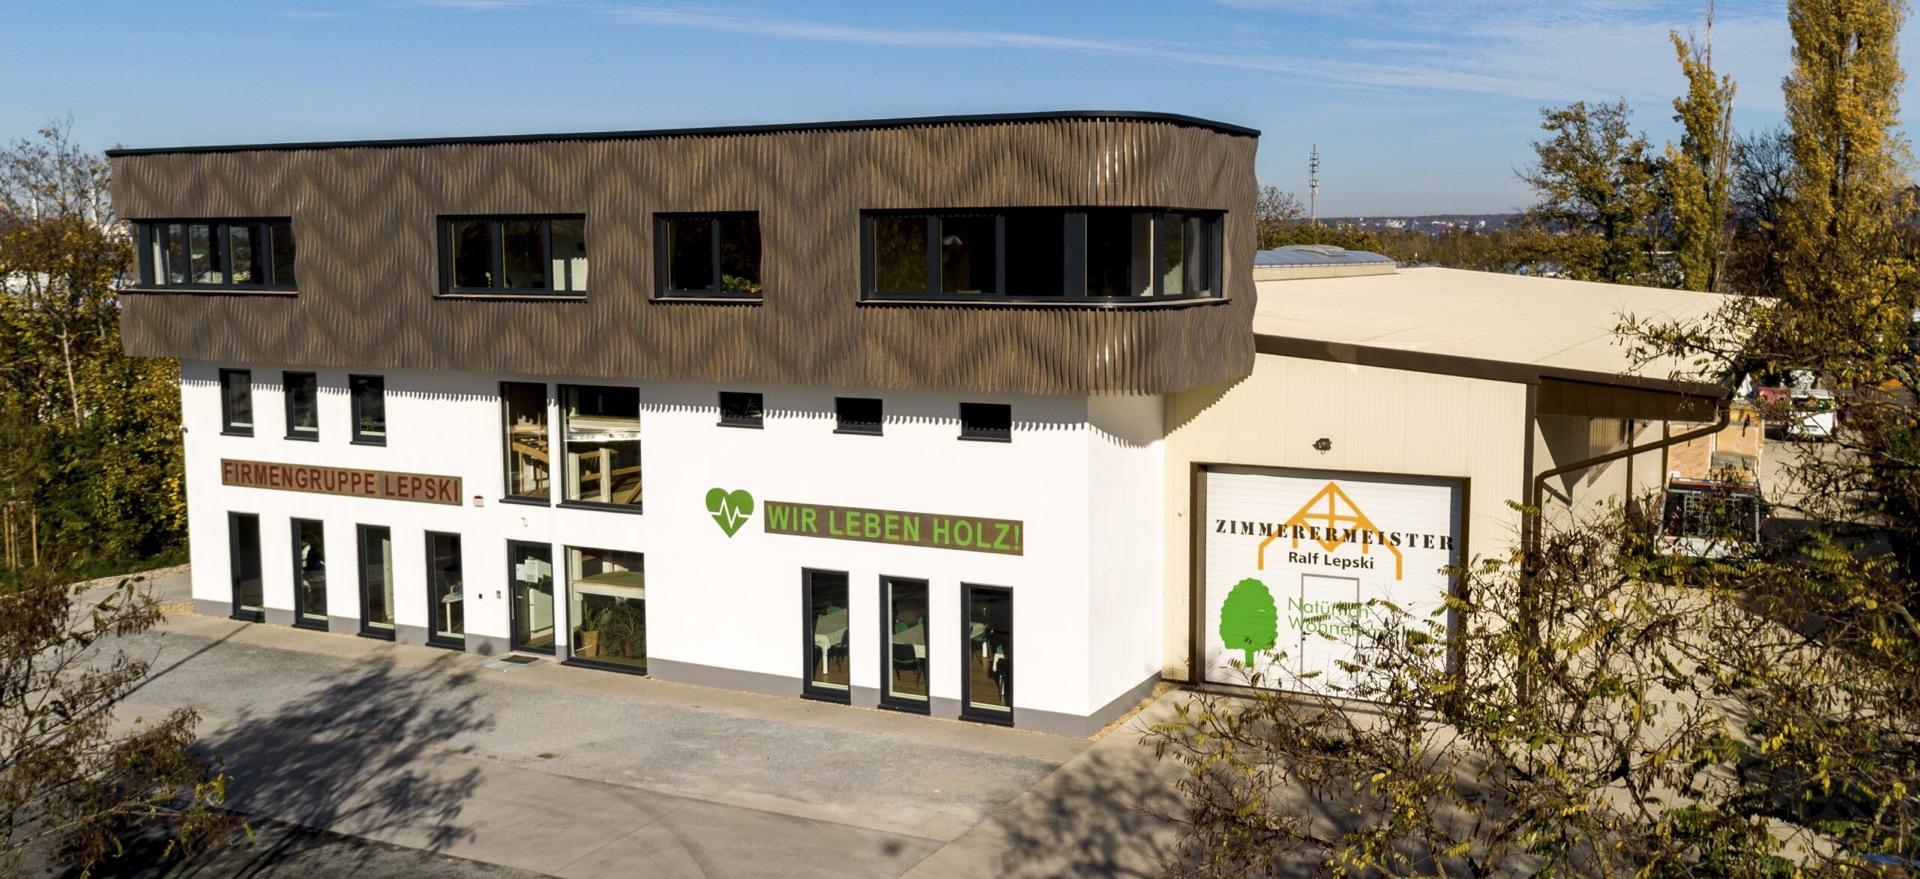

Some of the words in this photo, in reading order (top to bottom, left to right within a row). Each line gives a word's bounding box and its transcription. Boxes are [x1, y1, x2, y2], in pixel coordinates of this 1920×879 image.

[224, 462, 375, 495] FIRMENGRUPPE
[385, 475, 460, 502] LEPSKI
[768, 505, 818, 533] WIR
[829, 511, 919, 542] LEBEN
[932, 519, 1020, 551] HOLZ!
[1216, 519, 1455, 551] ZIMMERERMEISTER
[1288, 552, 1319, 565] Ralf
[1324, 555, 1374, 569] Lepski
